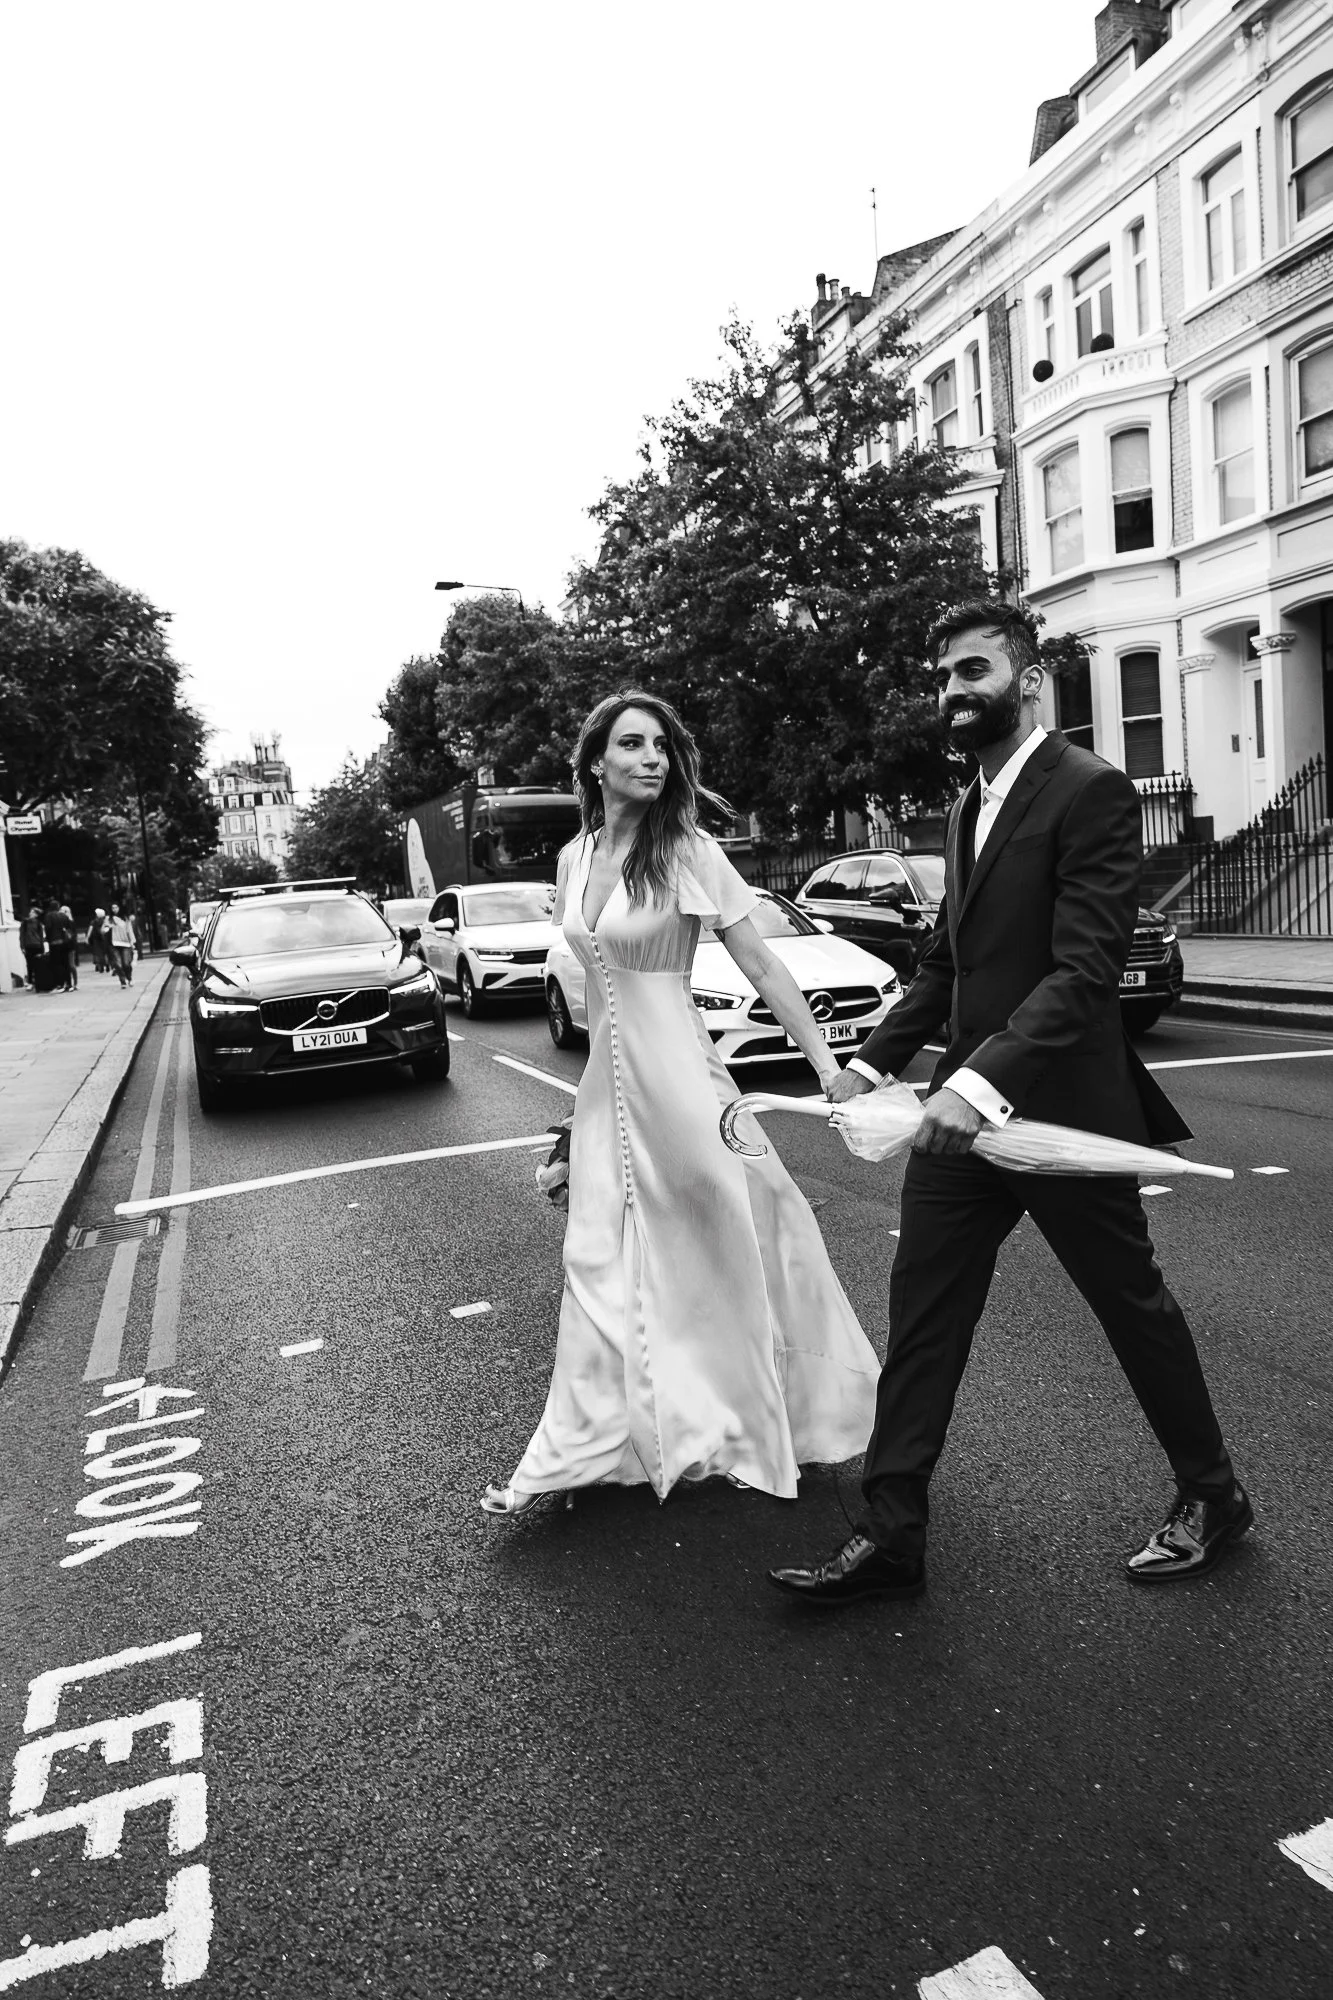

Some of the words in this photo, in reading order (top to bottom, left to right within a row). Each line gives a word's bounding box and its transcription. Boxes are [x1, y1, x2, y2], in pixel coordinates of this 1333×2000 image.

[301, 1034, 331, 1048] LY21
[829, 1024, 853, 1040] BWK
[60, 1408, 205, 1568] LOOK
[0, 1632, 213, 1989] LEFT
